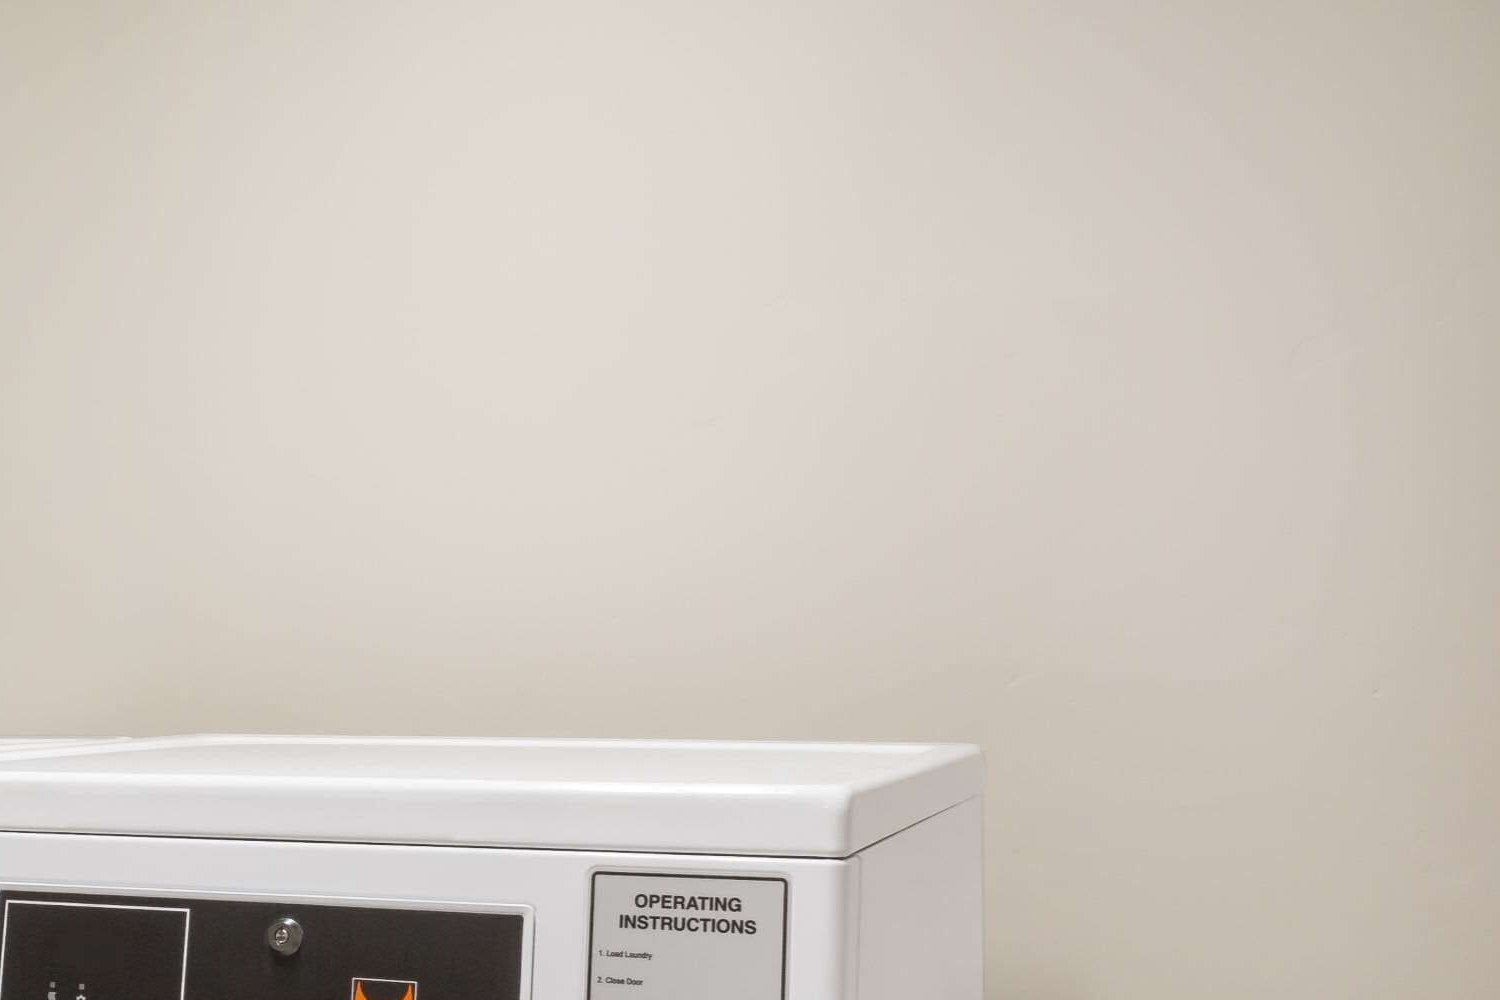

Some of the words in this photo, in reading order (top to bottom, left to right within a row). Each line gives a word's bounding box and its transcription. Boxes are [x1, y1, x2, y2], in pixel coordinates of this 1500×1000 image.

[635, 894, 742, 912] OPERATING
[619, 914, 757, 934] INSTRUCTIONS
[625, 952, 652, 960] Laundry
